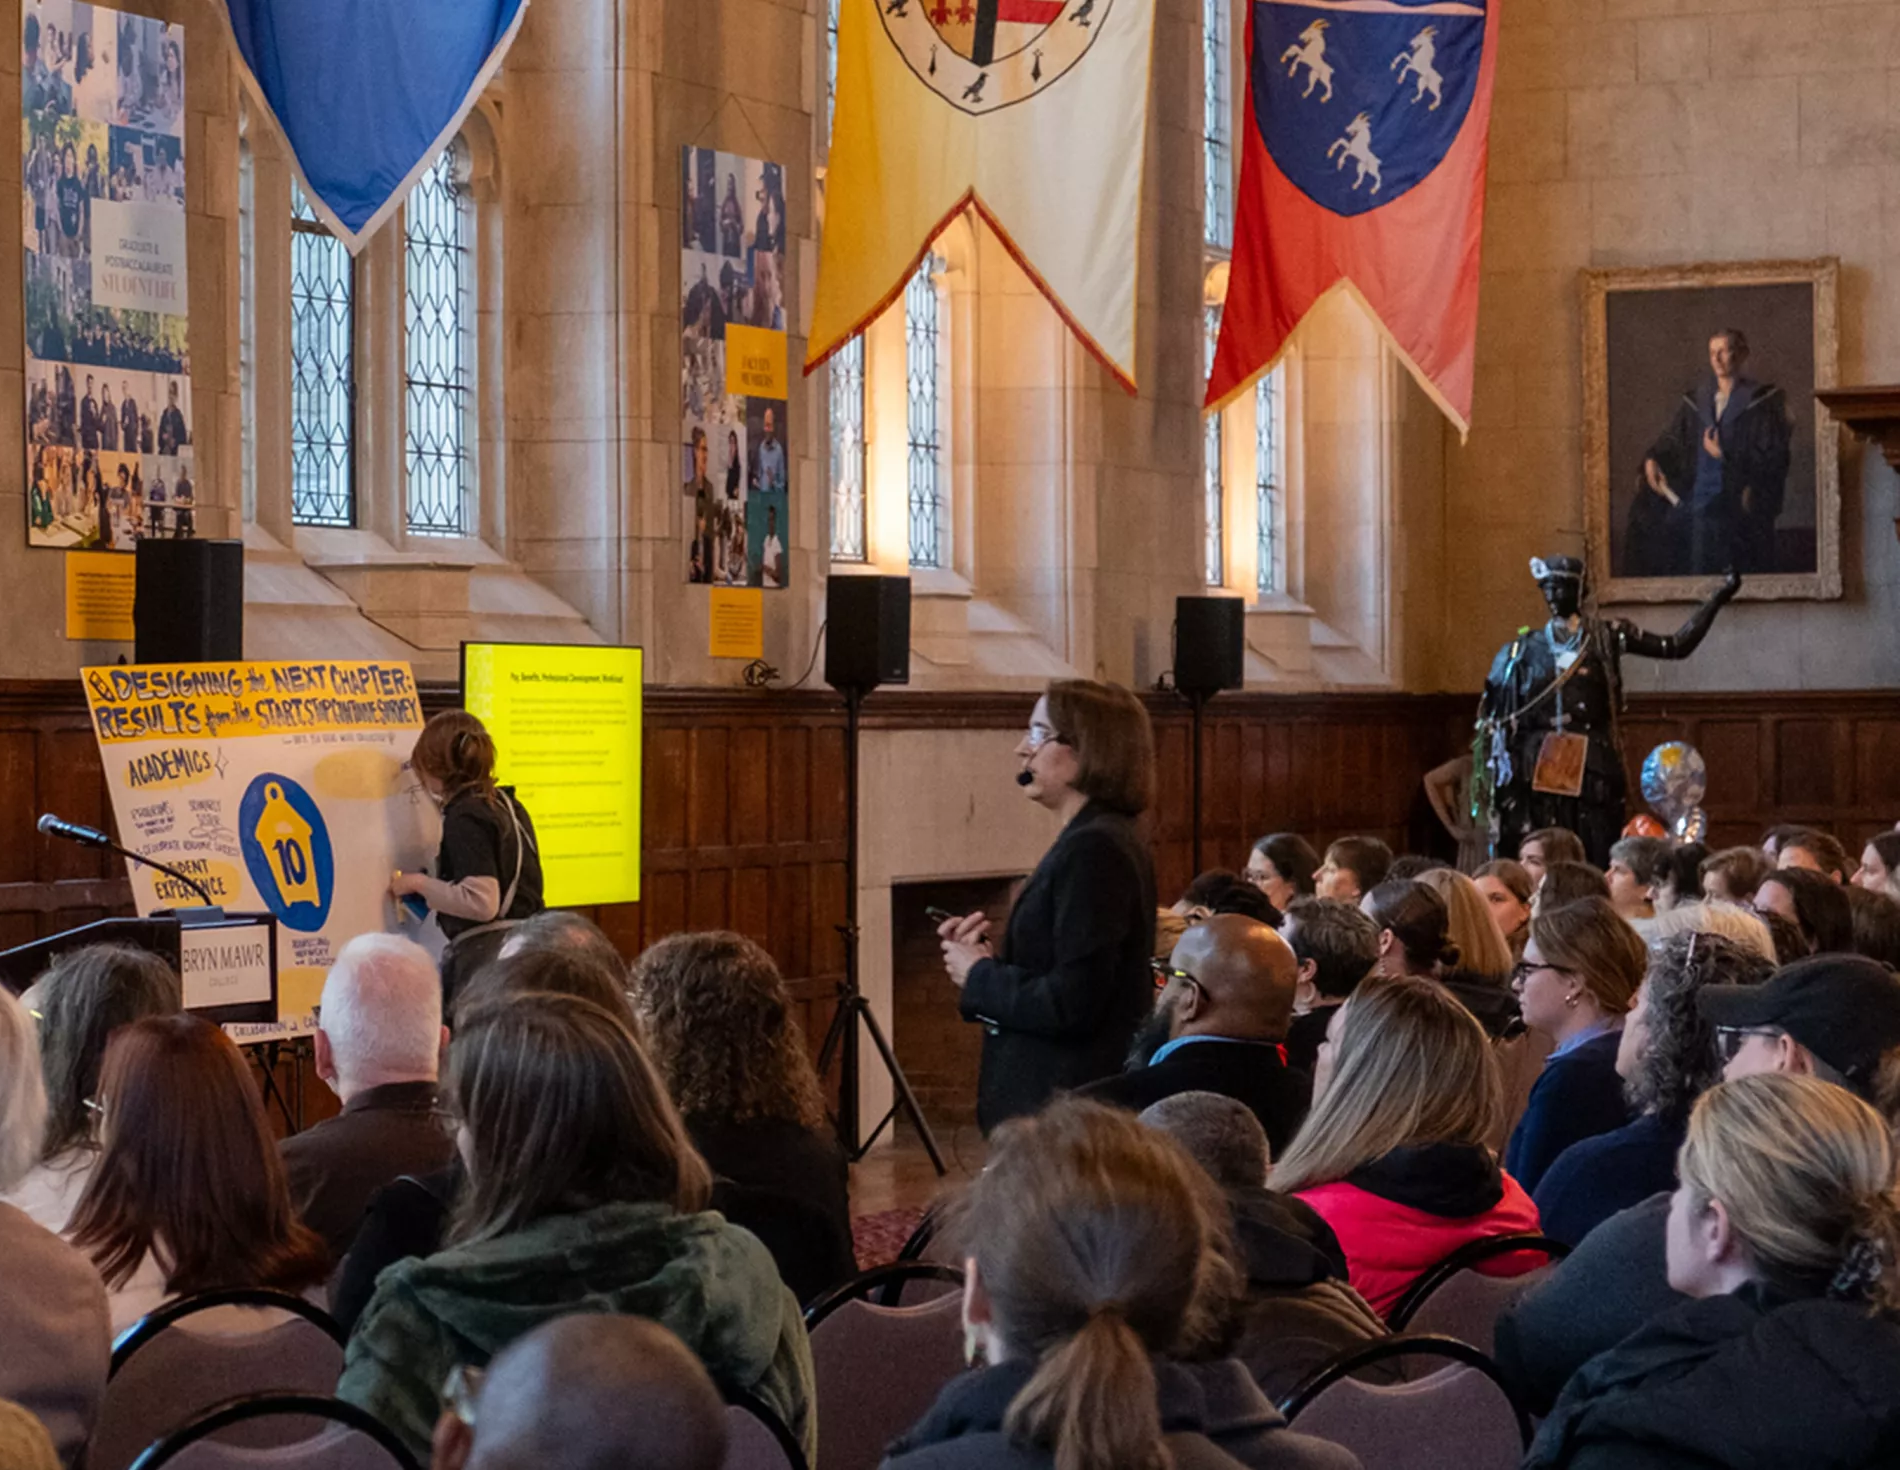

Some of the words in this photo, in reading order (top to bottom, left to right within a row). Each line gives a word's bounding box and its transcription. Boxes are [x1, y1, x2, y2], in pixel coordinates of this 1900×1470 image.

[110, 668, 243, 700] DESIGNING
[245, 667, 270, 692] the
[271, 665, 326, 693] NEXT
[330, 664, 413, 695] CHAPTER:
[96, 701, 201, 739] RESULTS
[128, 748, 211, 787] ACADEMICS
[273, 838, 307, 886] 10
[183, 946, 218, 973] BRYN
[220, 943, 265, 970] MAWR
